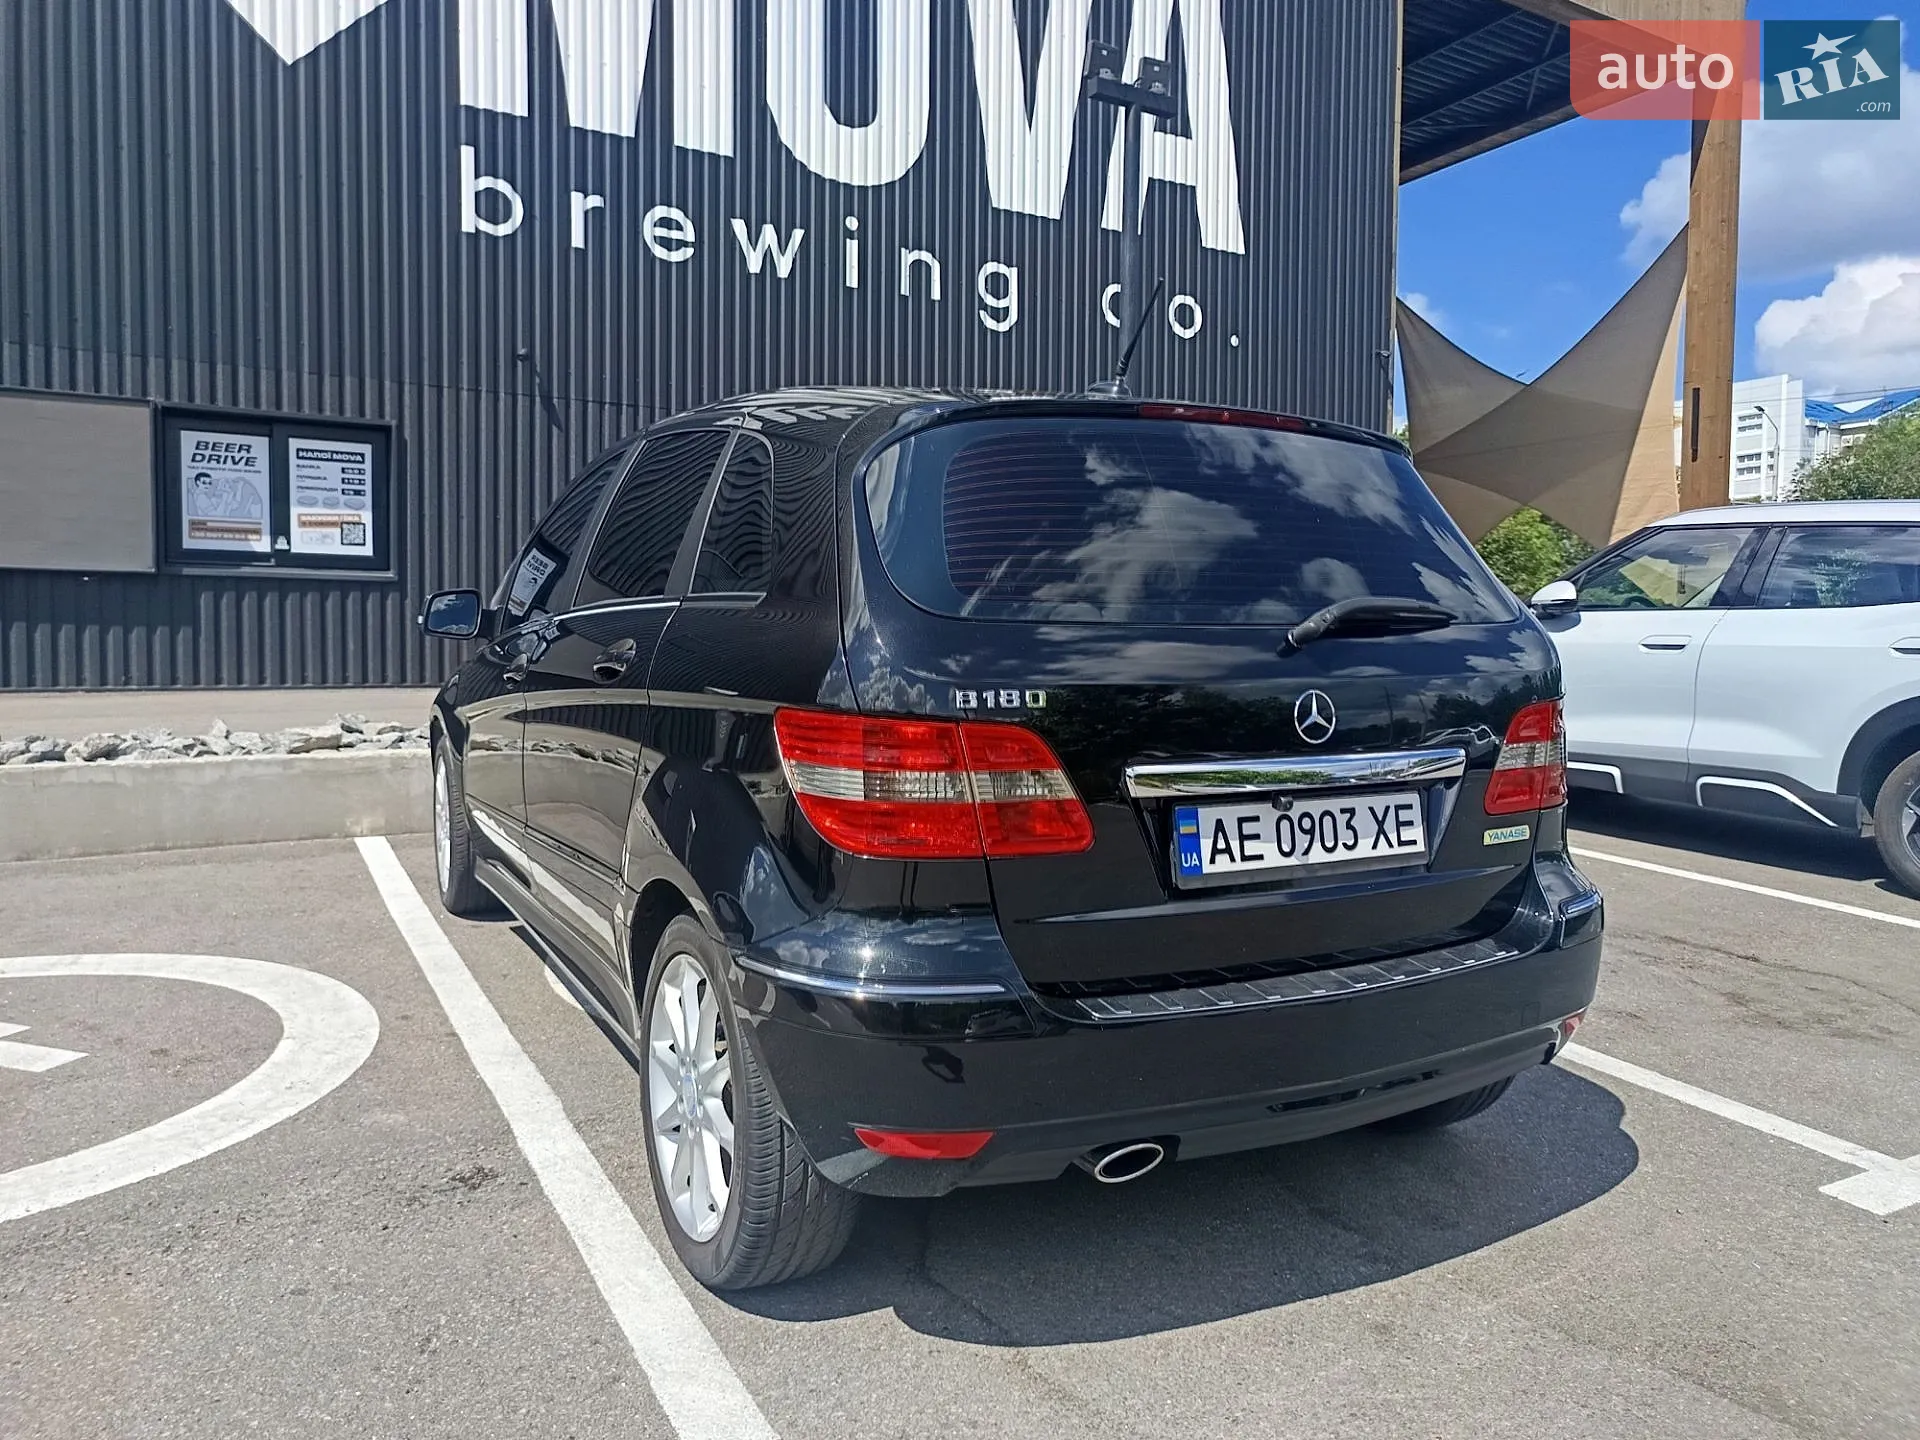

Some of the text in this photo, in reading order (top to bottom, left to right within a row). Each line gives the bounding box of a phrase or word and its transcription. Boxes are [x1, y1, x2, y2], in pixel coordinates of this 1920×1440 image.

[459, 144, 1019, 333] brewing
[195, 440, 252, 454] BEER
[191, 452, 258, 467] DRIVE
[954, 688, 1047, 709] B180
[1208, 803, 1418, 865] AE 0903 XE
[1487, 827, 1528, 841] YANASE
[1181, 856, 1200, 867] UA
